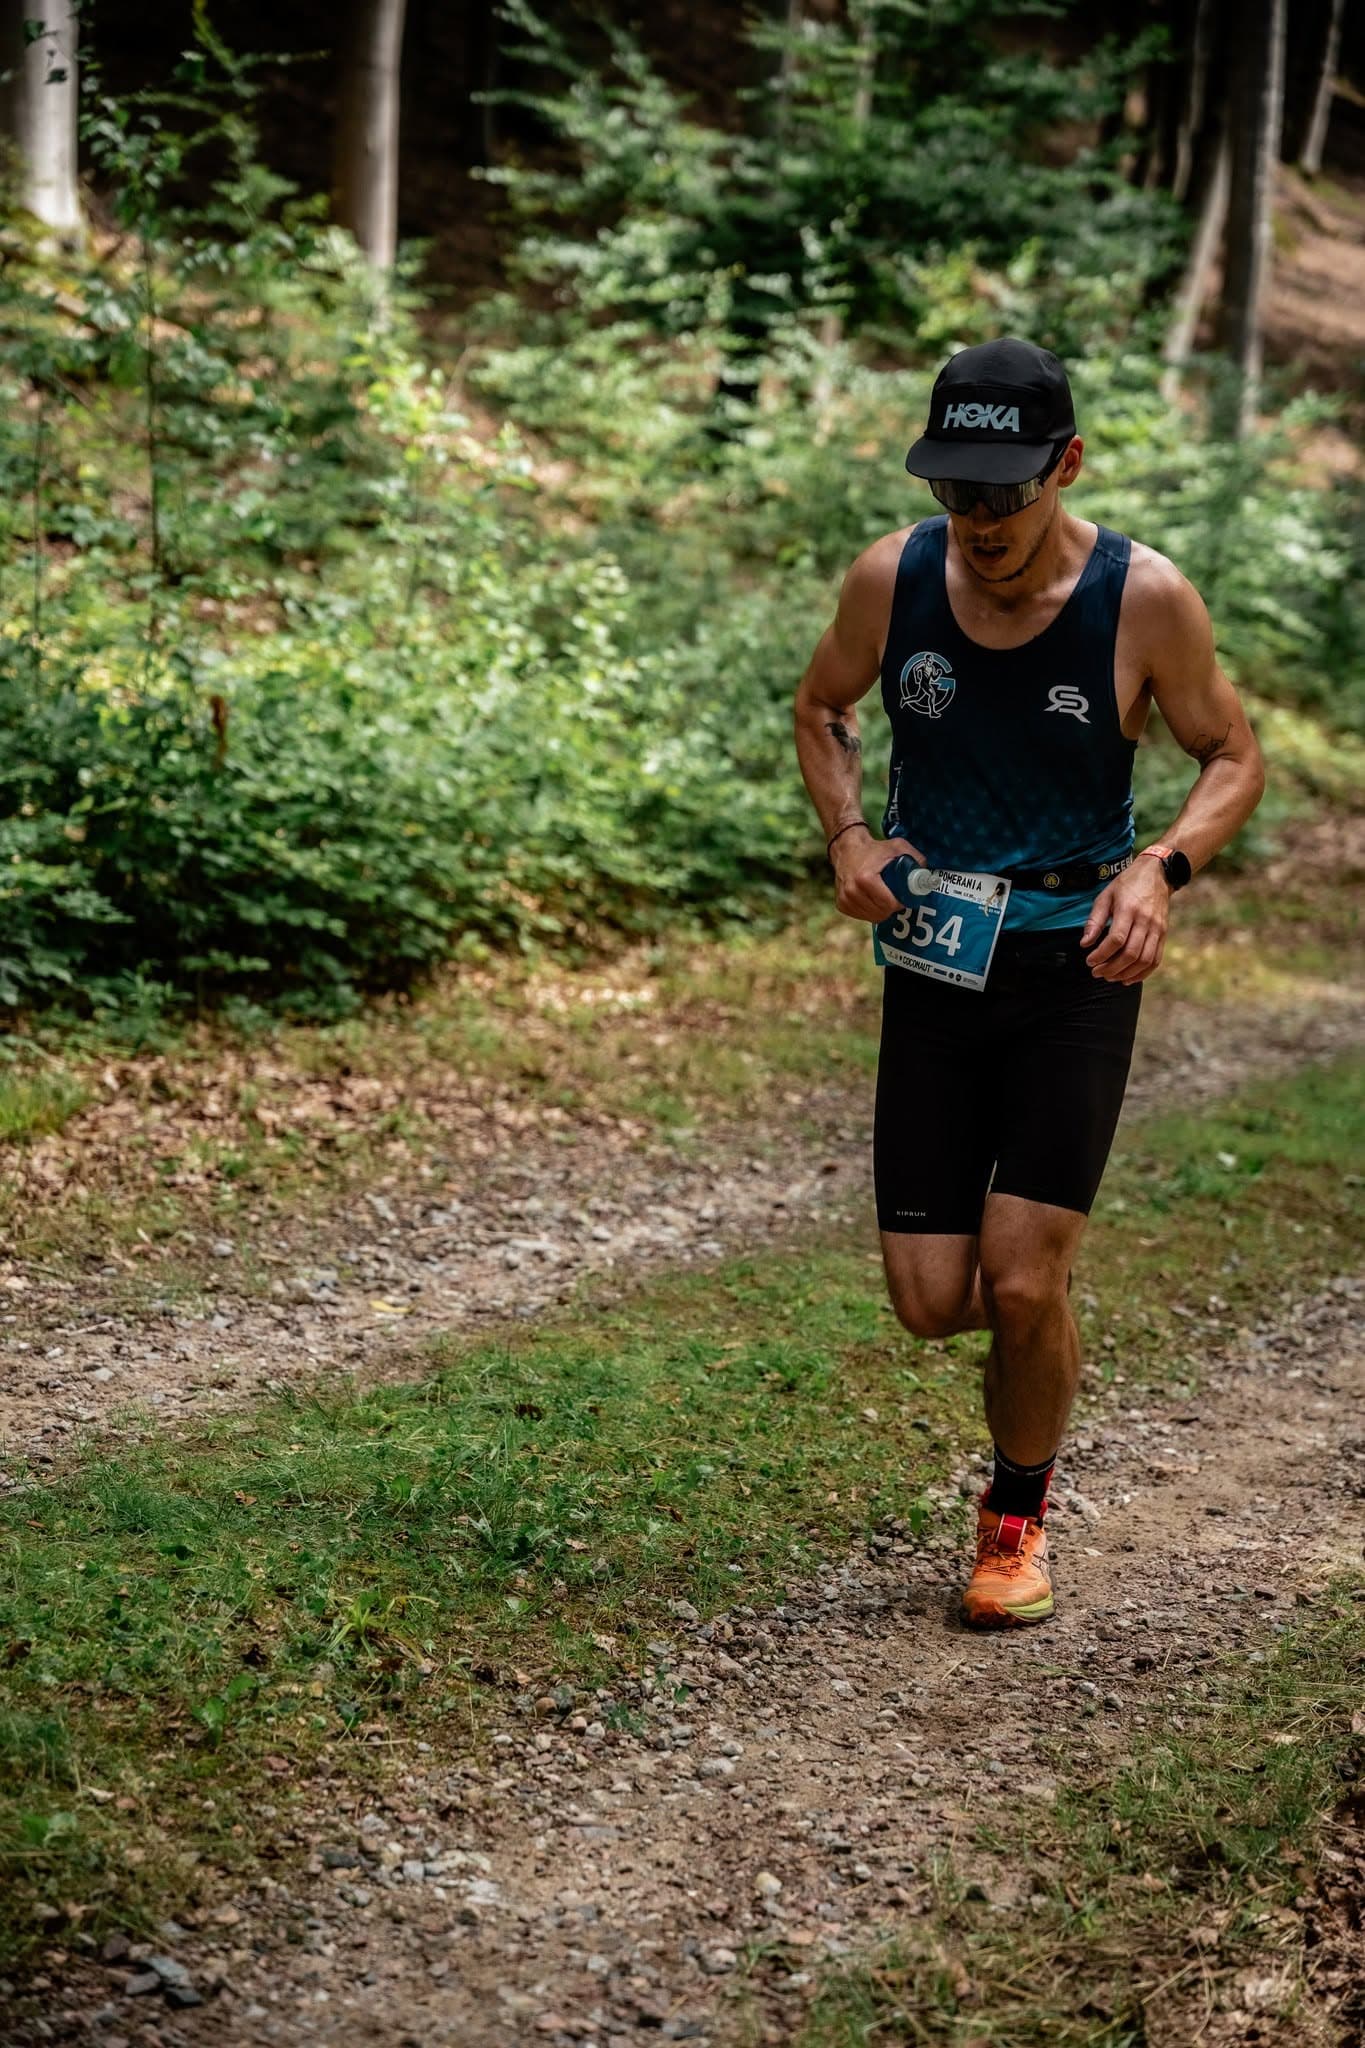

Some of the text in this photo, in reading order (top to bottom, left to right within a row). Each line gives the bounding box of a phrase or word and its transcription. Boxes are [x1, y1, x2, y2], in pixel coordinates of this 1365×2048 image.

[942, 402, 1020, 433] HOKA
[1110, 854, 1133, 875] ICEB
[892, 904, 963, 957] 354
[902, 956, 933, 974] COCONAUT
